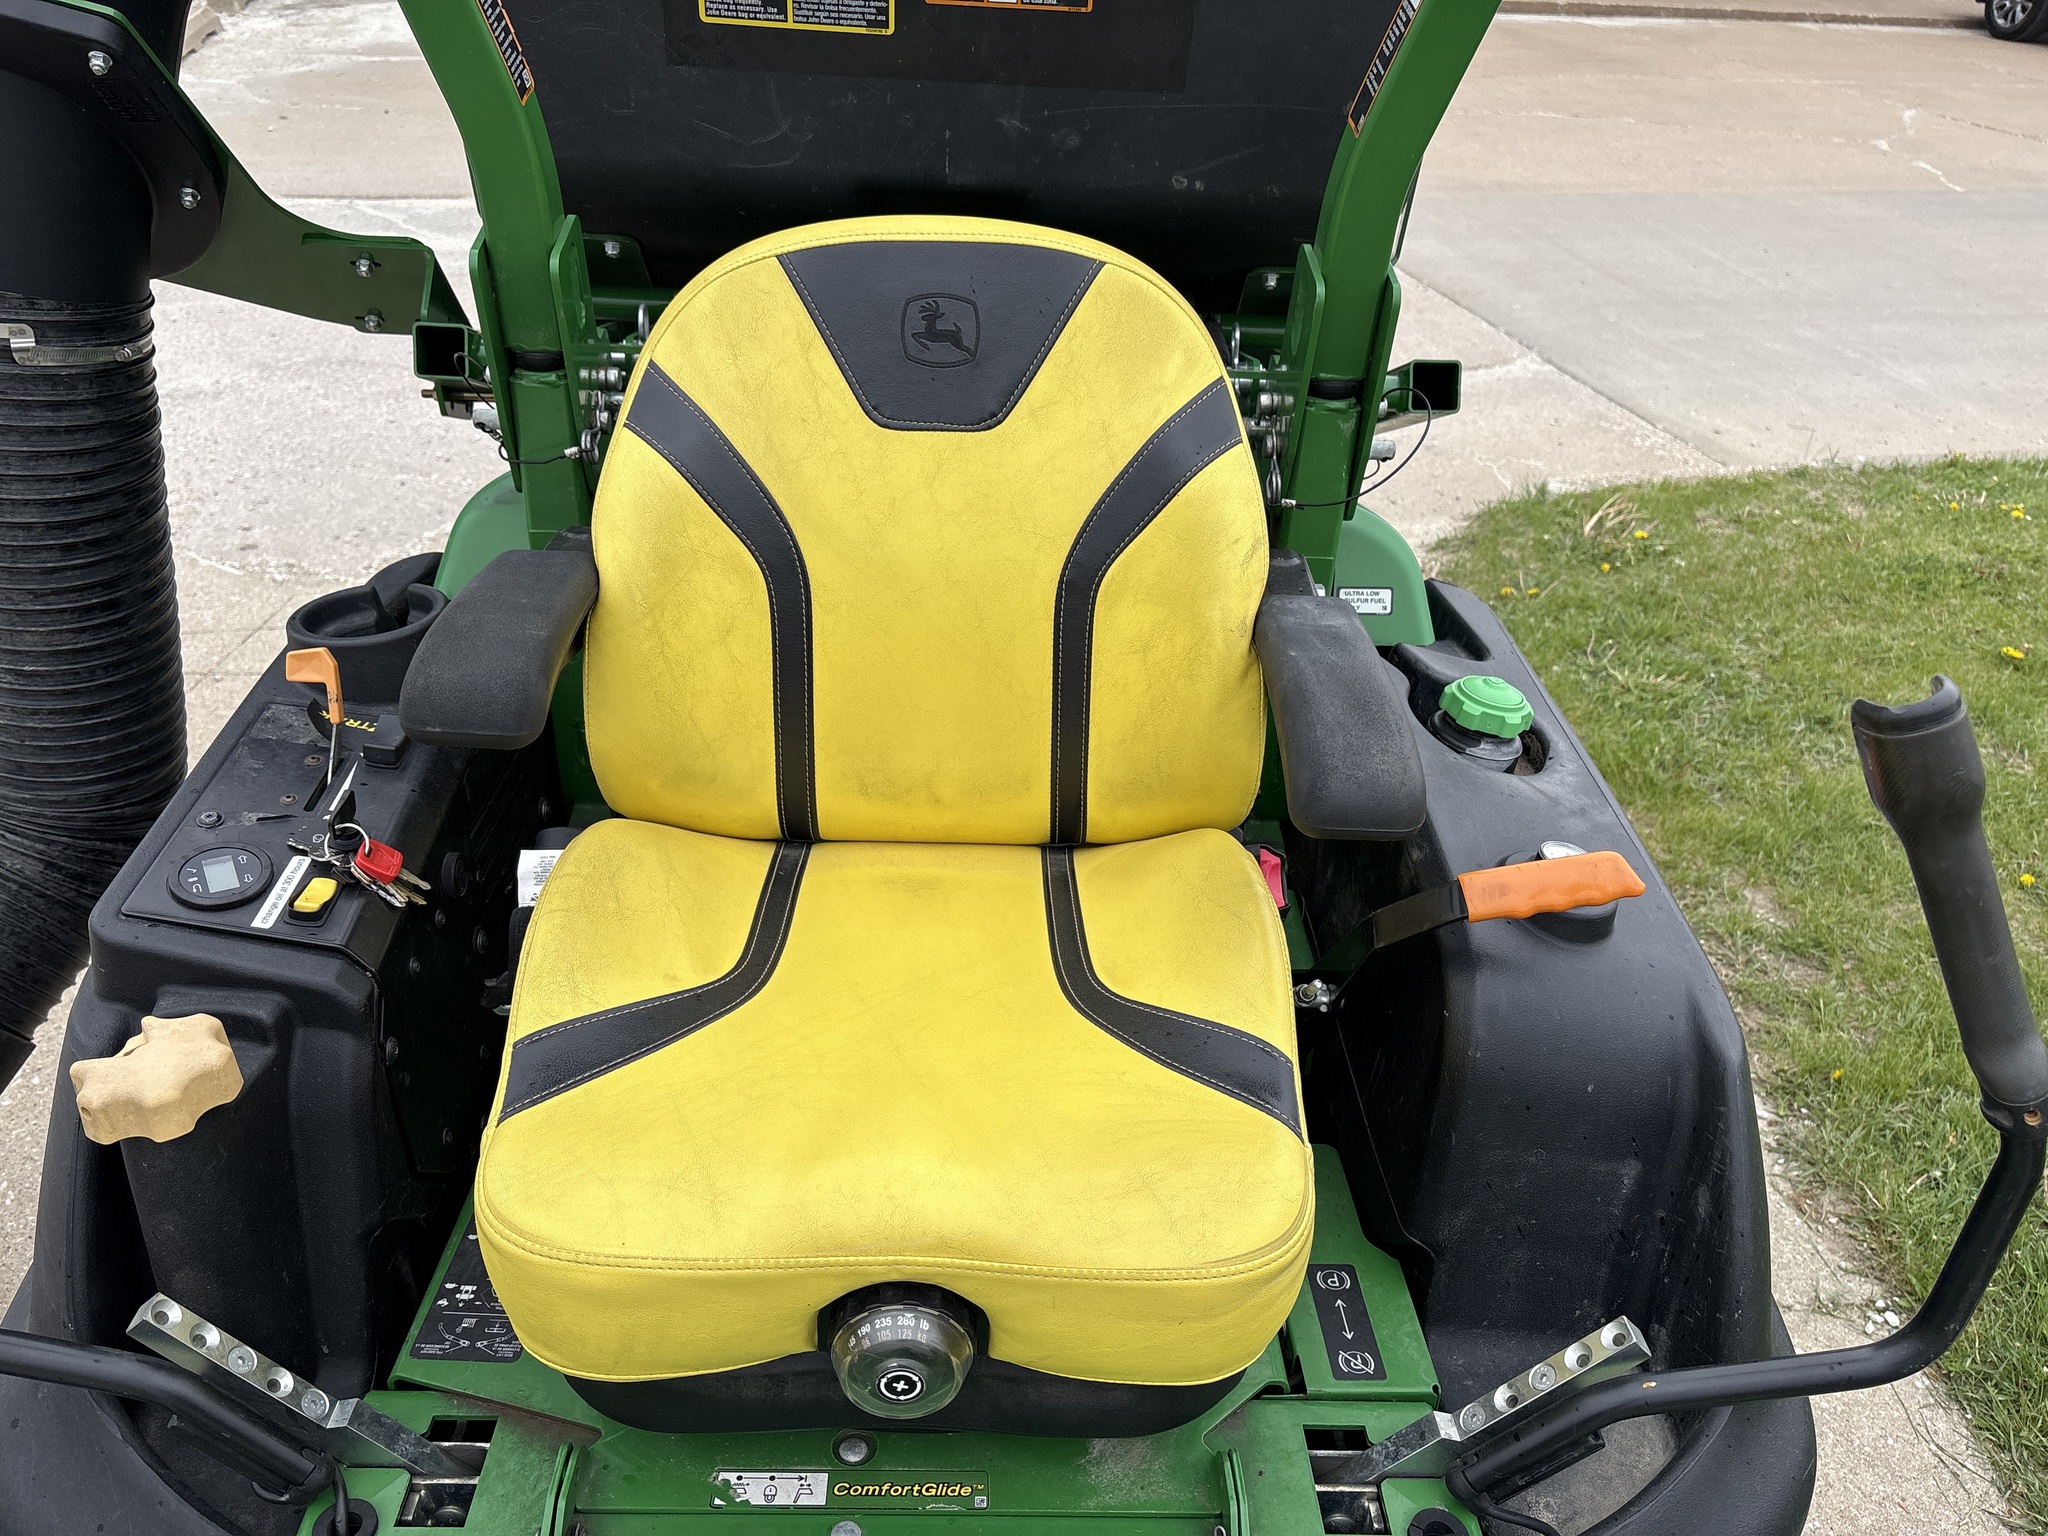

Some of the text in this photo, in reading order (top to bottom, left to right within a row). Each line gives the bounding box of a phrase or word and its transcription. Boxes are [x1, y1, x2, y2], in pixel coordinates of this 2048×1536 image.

[737, 5, 766, 13] necessary.
[793, 8, 814, 16] Sustituir
[839, 5, 877, 14] frecuentemente.
[738, 10, 748, 19] bag
[756, 12, 786, 20] equivalent.
[261, 901, 279, 924] change
[275, 892, 285, 901] oil
[282, 874, 296, 886] 300
[289, 858, 306, 875] hours
[857, 1323, 871, 1337] 190
[874, 1316, 893, 1329] 235
[896, 1315, 915, 1327] 280
[919, 1318, 930, 1331] lb
[876, 1329, 891, 1342] 105
[897, 1329, 913, 1340] 125
[917, 1331, 927, 1343] kg
